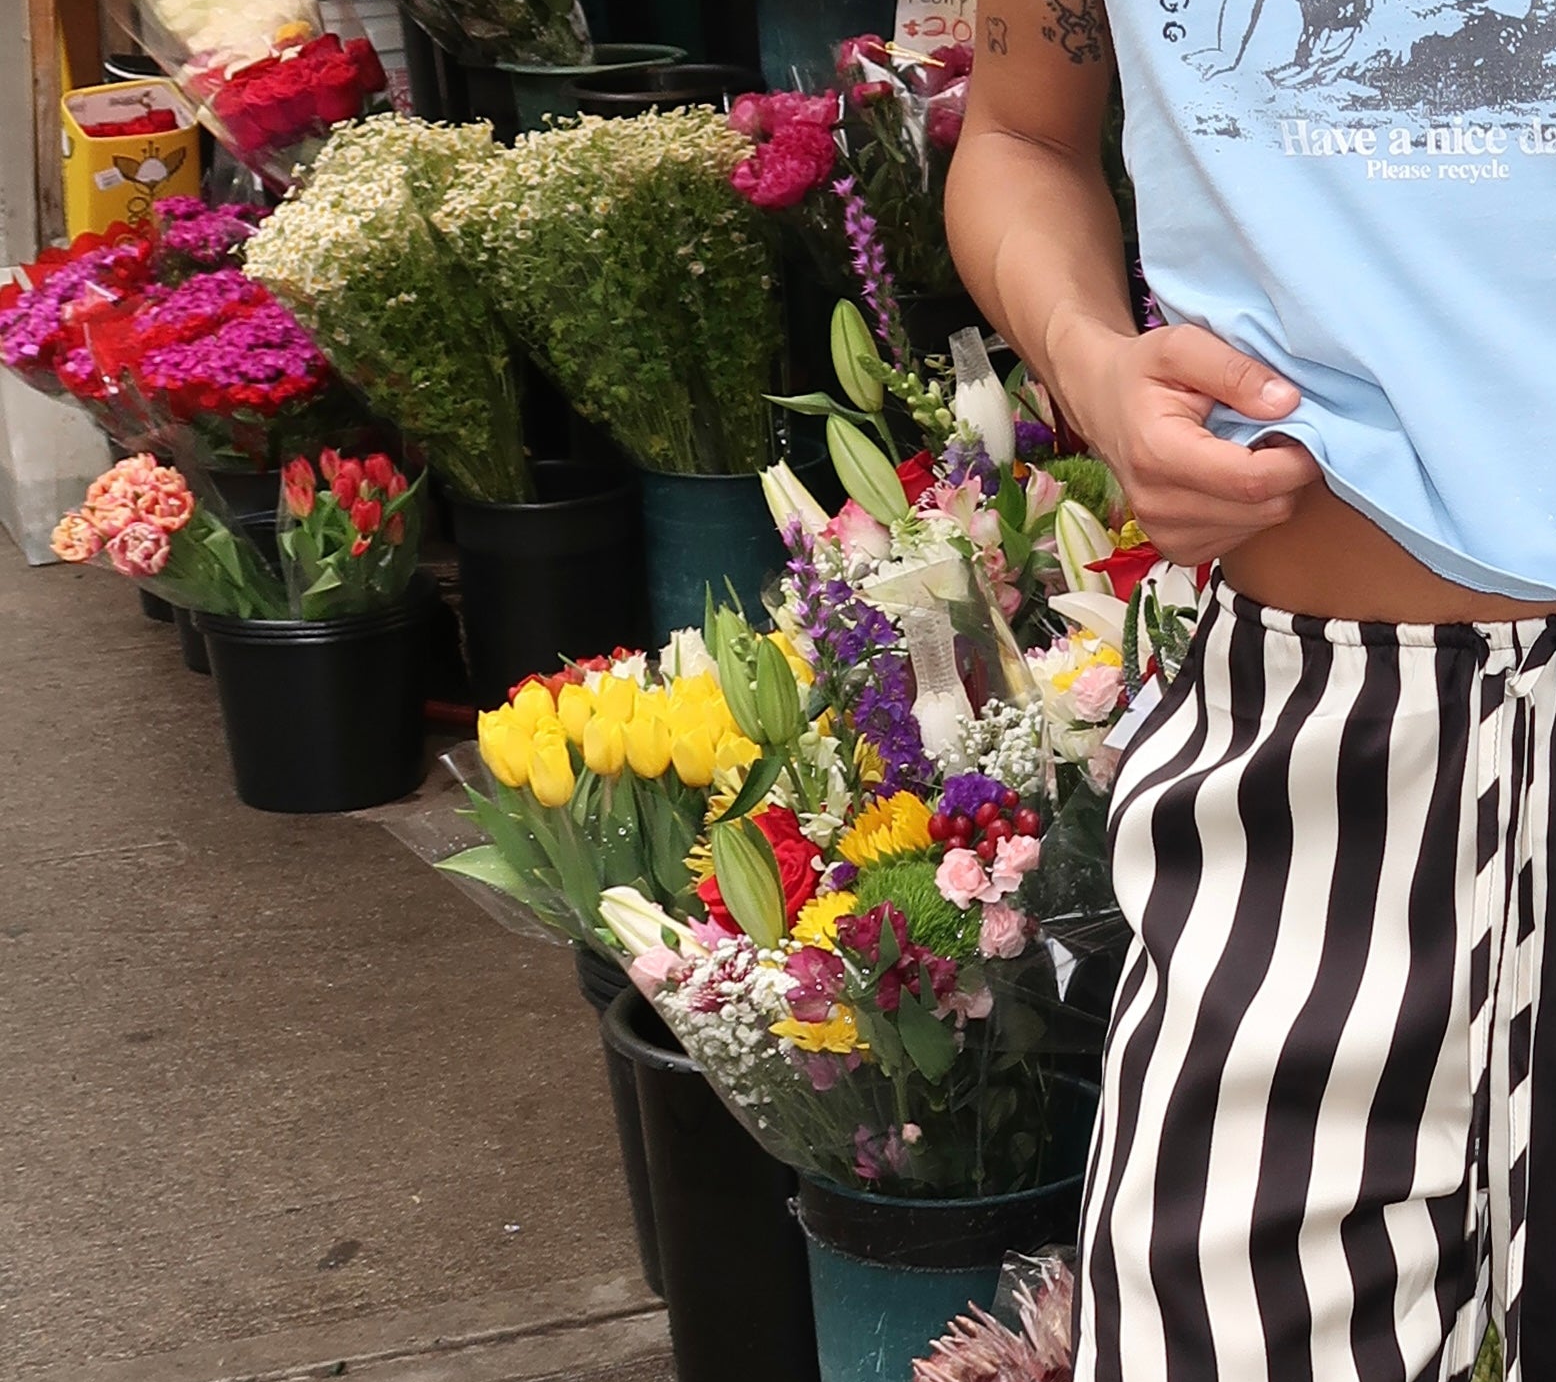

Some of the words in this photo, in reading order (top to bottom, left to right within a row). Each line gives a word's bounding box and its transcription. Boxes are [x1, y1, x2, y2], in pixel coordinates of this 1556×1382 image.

[1281, 118, 1377, 157] Have
[1388, 125, 1414, 157] a
[1426, 116, 1510, 157] nice
[1366, 159, 1432, 180] Please
[1437, 159, 1511, 185] recycle
